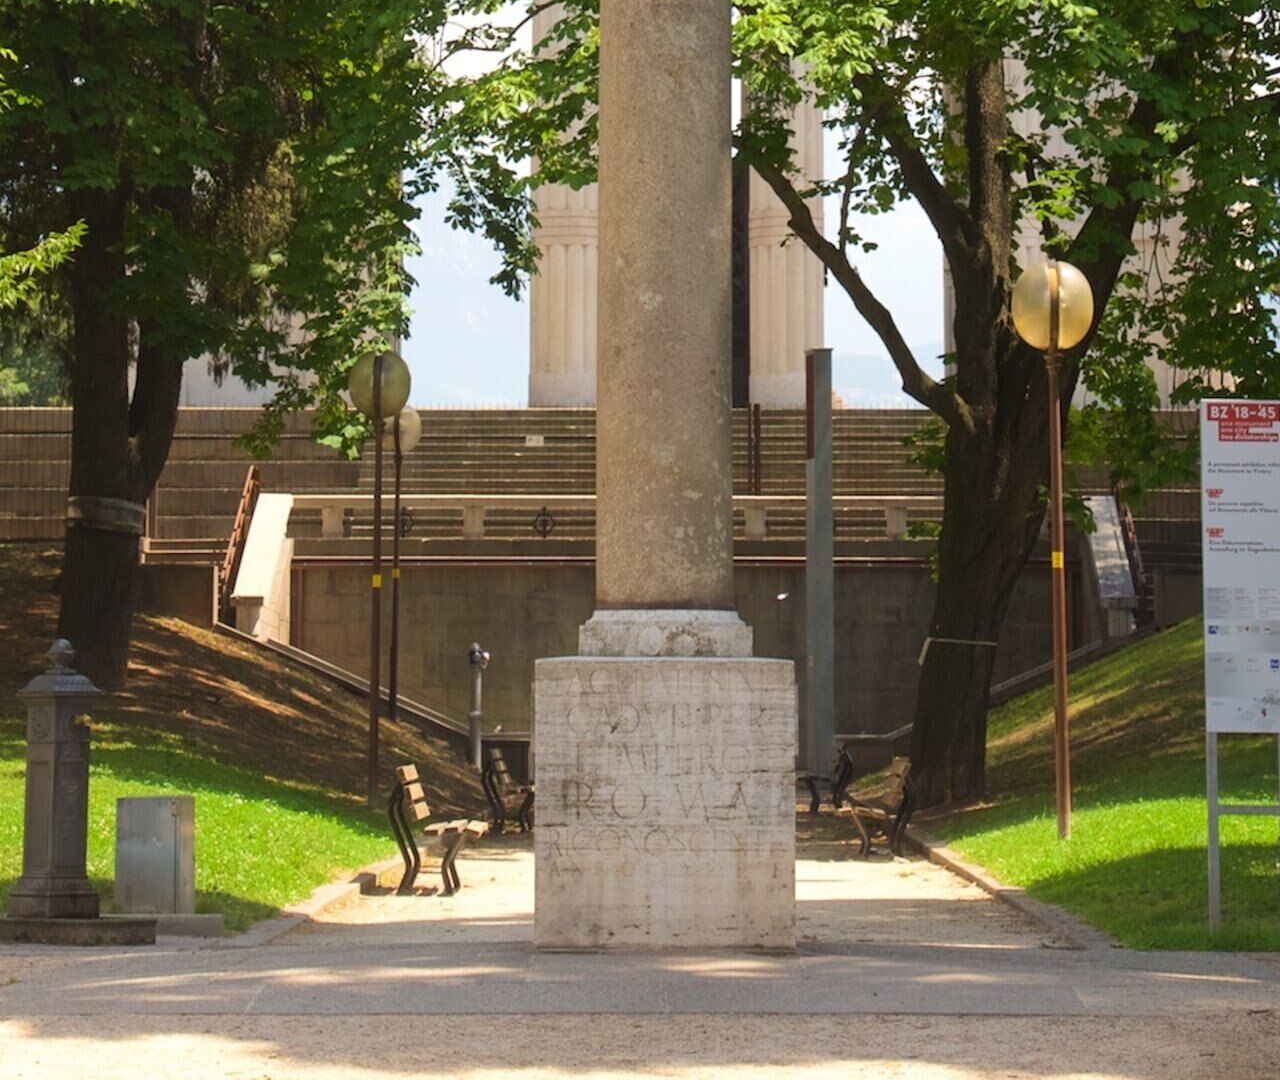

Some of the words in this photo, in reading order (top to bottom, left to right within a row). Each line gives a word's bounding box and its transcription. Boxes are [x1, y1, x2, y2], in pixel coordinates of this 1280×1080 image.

[1210, 405, 1229, 419] BZ
[1234, 427, 1248, 435] city
[572, 781, 754, 823] ROMA
